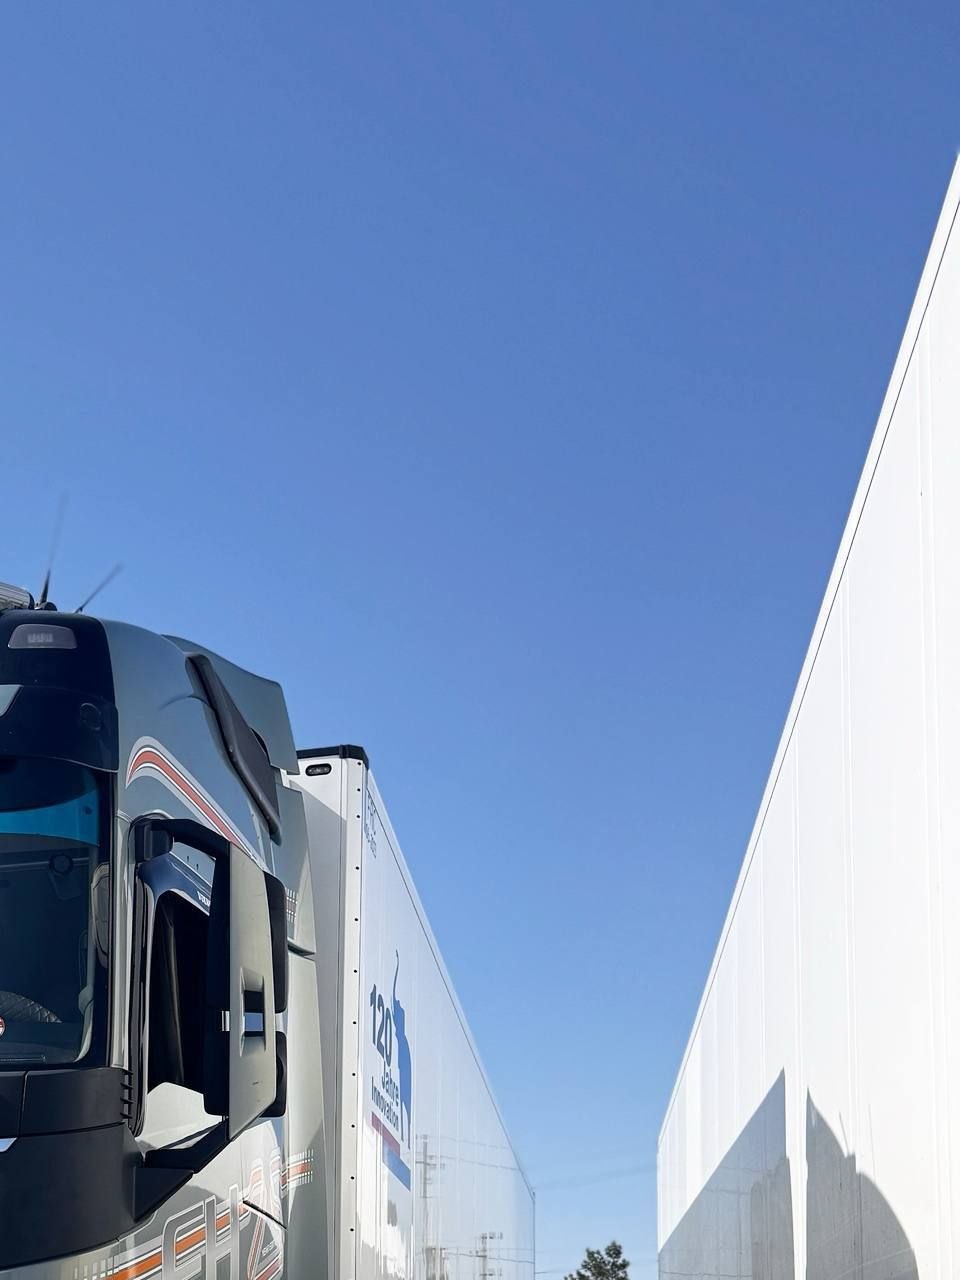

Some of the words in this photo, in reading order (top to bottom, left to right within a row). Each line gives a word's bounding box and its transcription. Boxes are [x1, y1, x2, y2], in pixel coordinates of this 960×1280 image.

[370, 983, 392, 1067] 120
[371, 1076, 399, 1132] Innovation
[381, 1062, 399, 1107] Jahre
